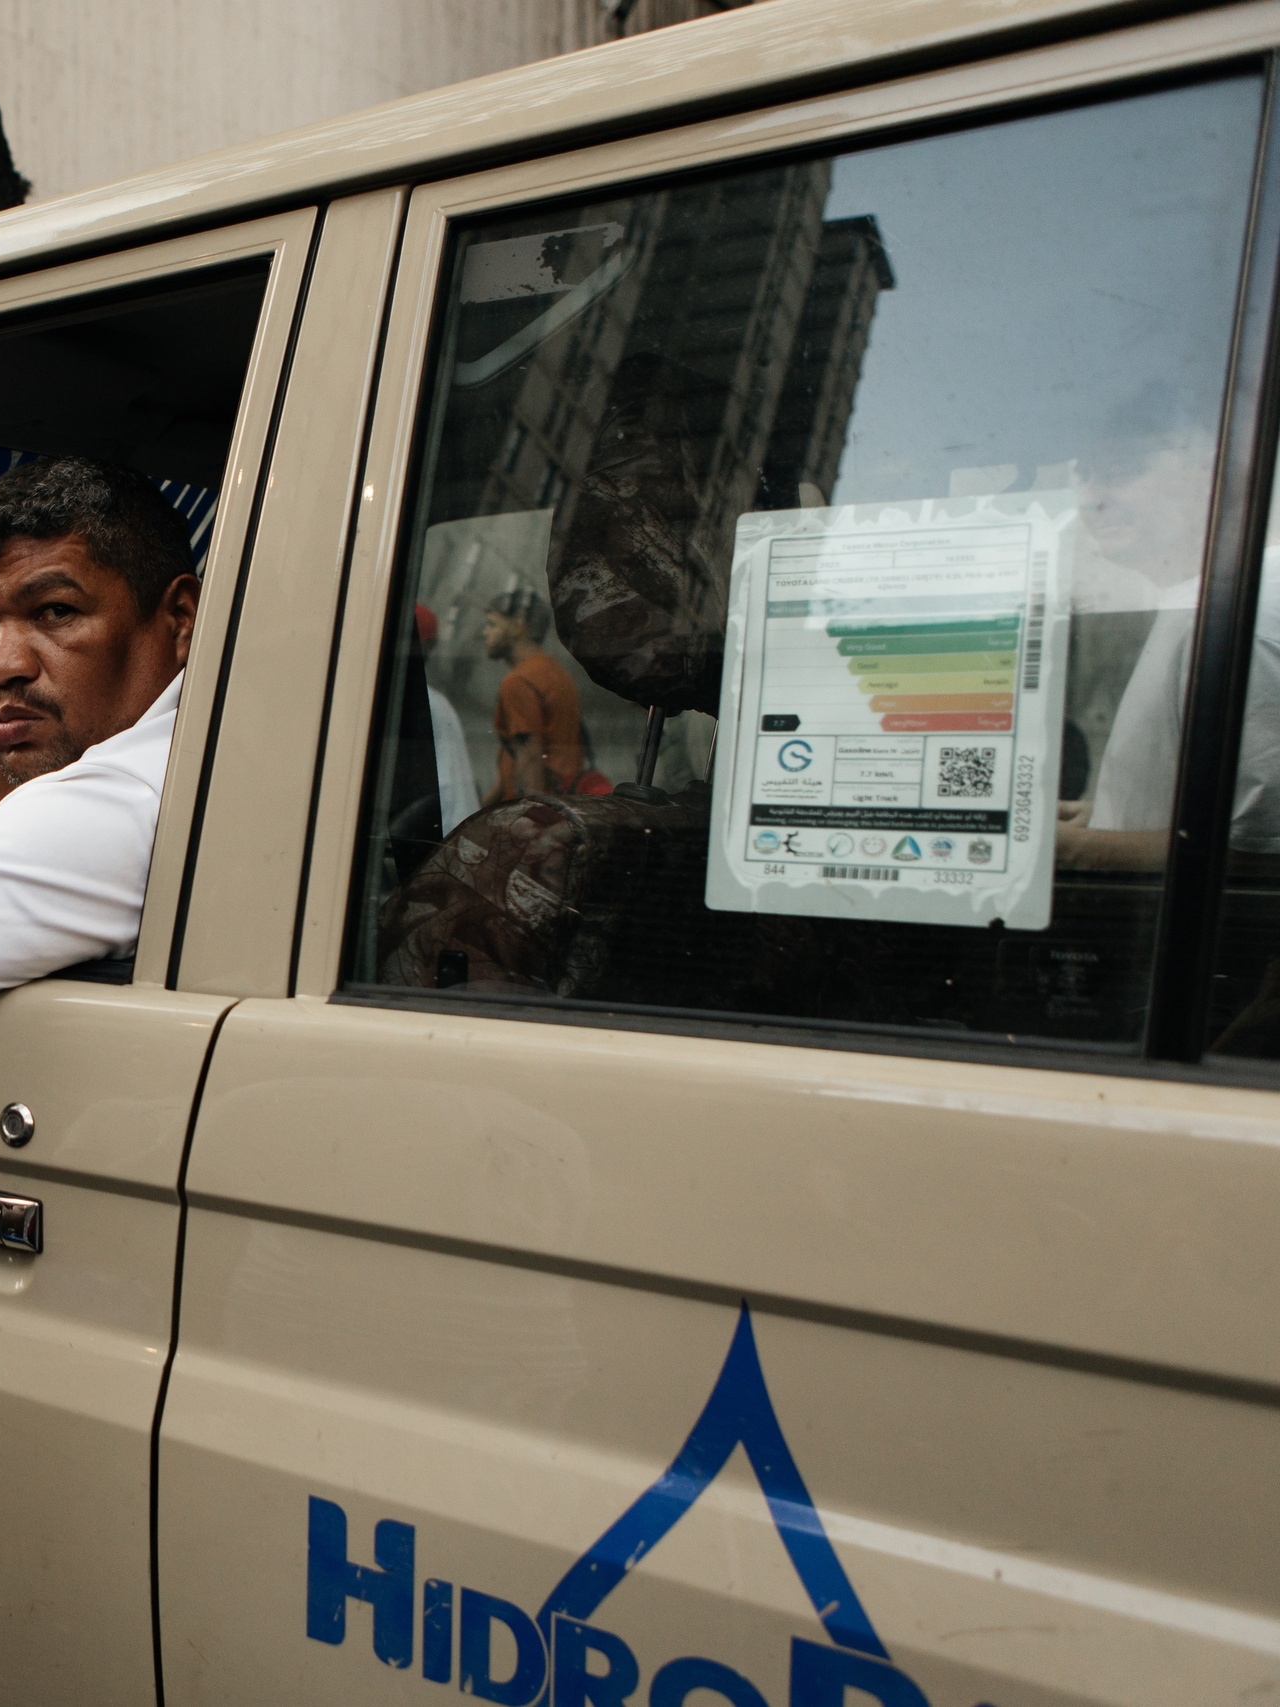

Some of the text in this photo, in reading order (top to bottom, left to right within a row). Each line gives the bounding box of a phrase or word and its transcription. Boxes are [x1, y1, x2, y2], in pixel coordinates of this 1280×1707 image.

[775, 579, 808, 587] TOYOTA
[857, 661, 879, 670] Good
[852, 795, 873, 803] Light
[763, 864, 785, 875] 844
[933, 872, 974, 885] 33332
